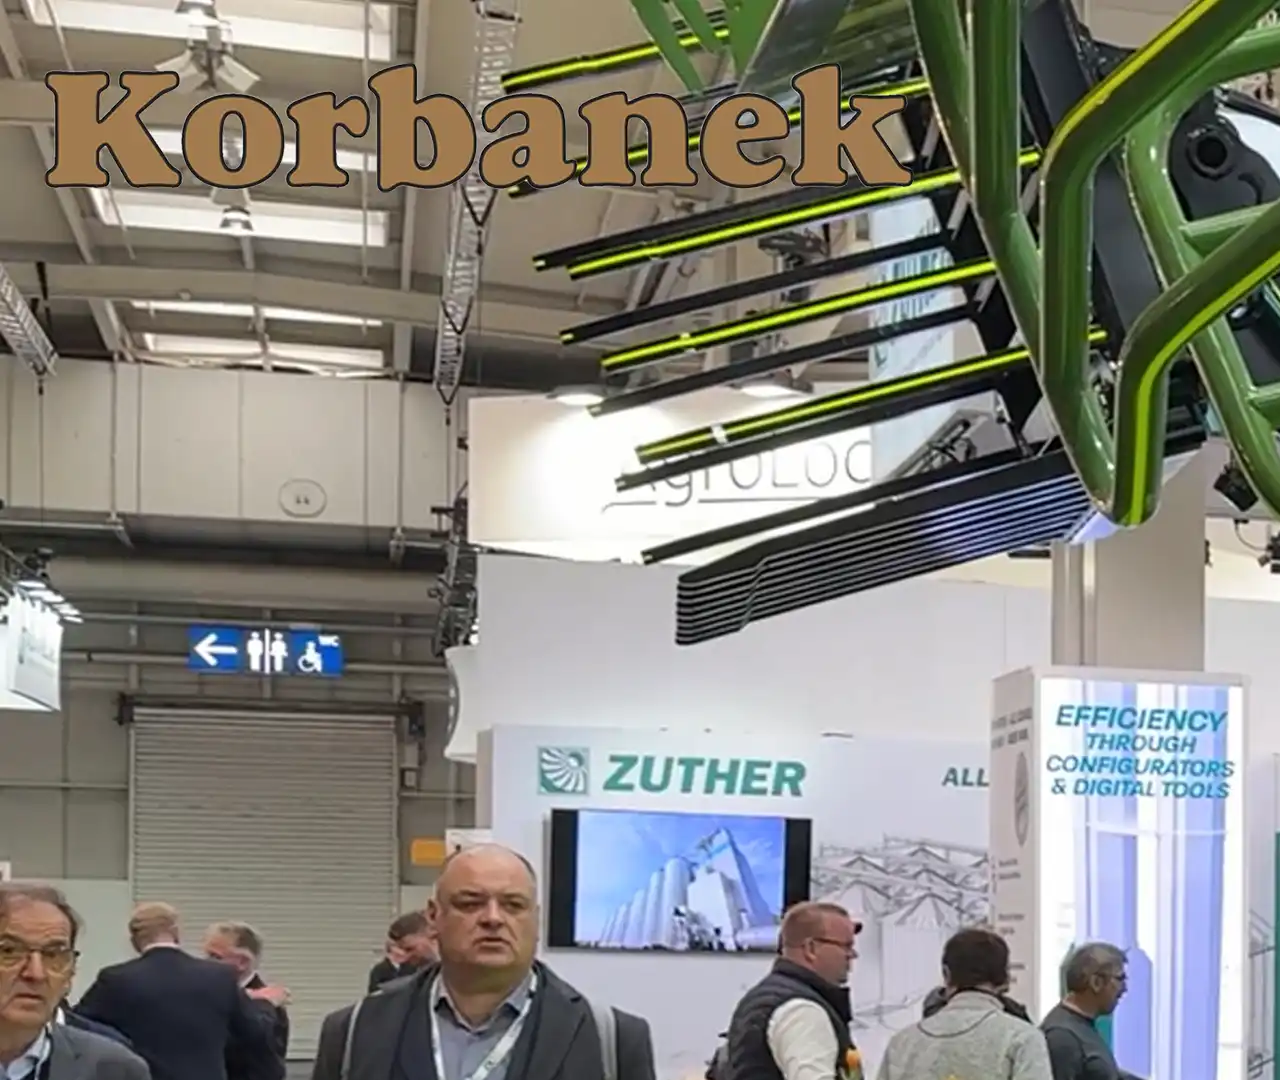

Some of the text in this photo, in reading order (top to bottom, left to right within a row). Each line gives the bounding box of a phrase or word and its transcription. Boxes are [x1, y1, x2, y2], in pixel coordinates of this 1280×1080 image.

[1055, 703, 1229, 733] EFFICIENCY
[1086, 733, 1198, 753] THROUGH
[602, 754, 807, 797] ZUTHER
[1046, 754, 1236, 778] CONFIGURATORS
[1050, 778, 1231, 799] & DIGITAL TOOLS
